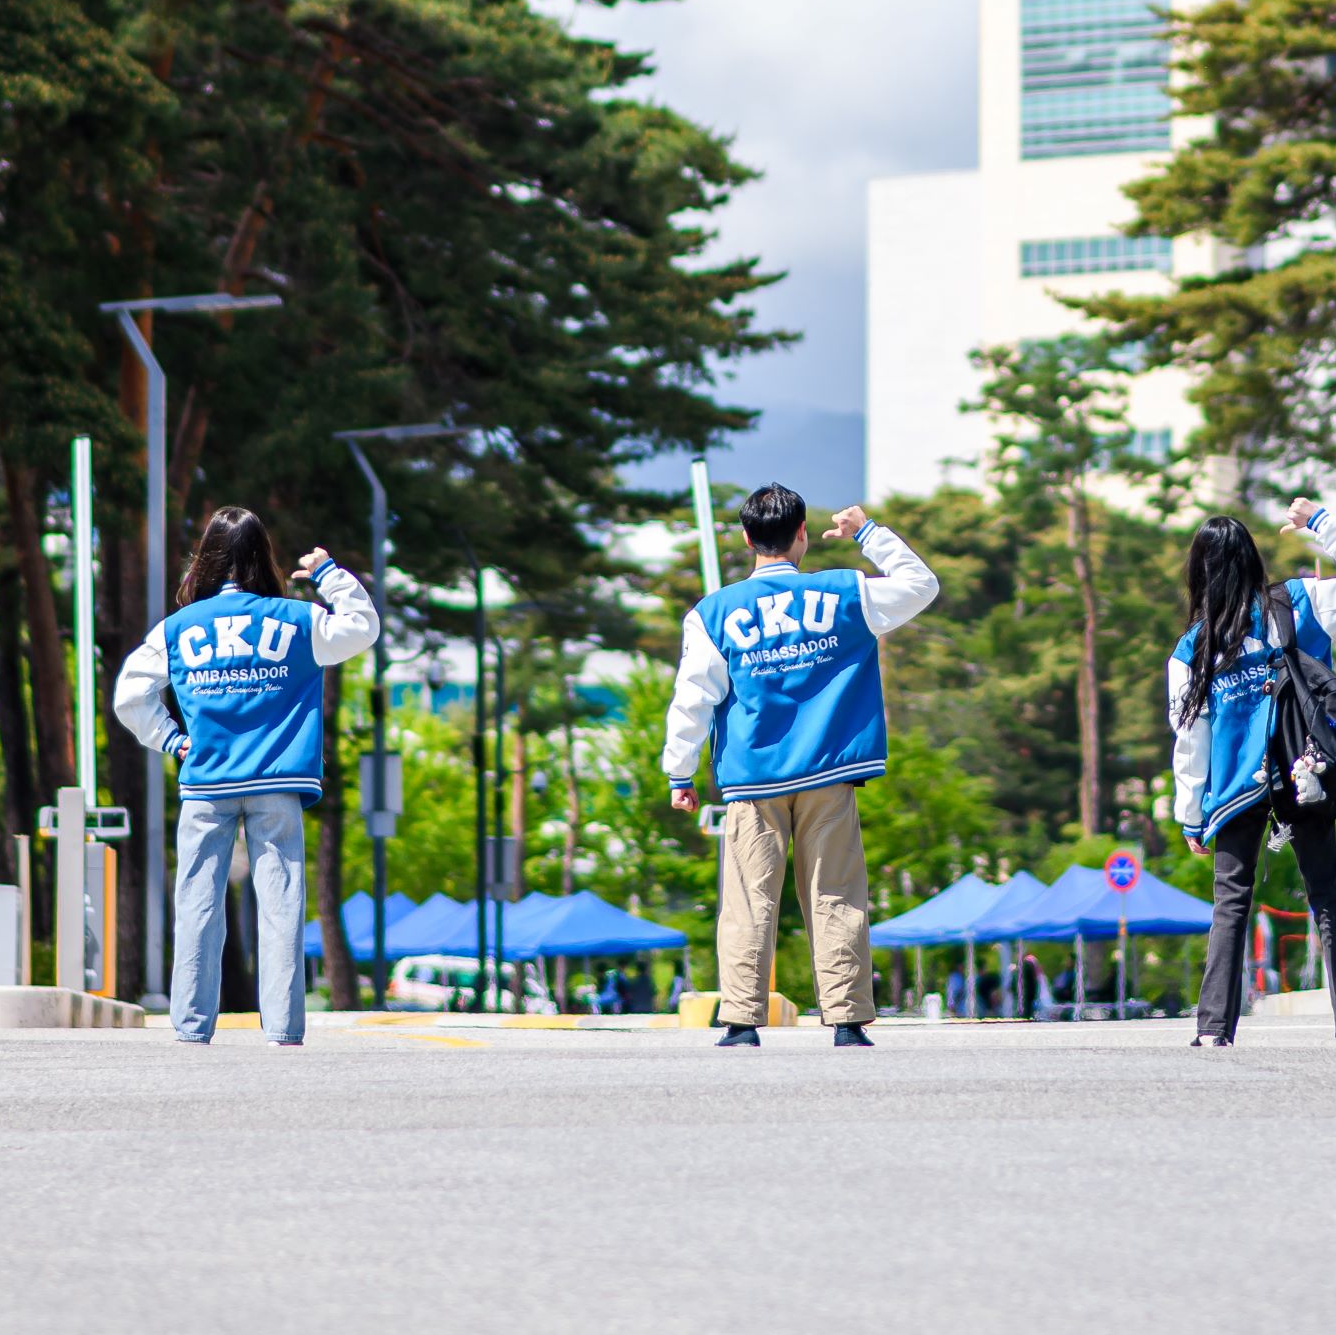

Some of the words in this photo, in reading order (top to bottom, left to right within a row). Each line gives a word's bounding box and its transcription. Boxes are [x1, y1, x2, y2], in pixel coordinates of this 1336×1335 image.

[724, 589, 840, 649] CKU
[178, 614, 297, 668] CKU
[740, 635, 839, 667] AMBASSADOR
[186, 665, 289, 685] AMBASSADOR
[264, 682, 284, 692] Univ.
[1211, 664, 1267, 694] AMBASS
